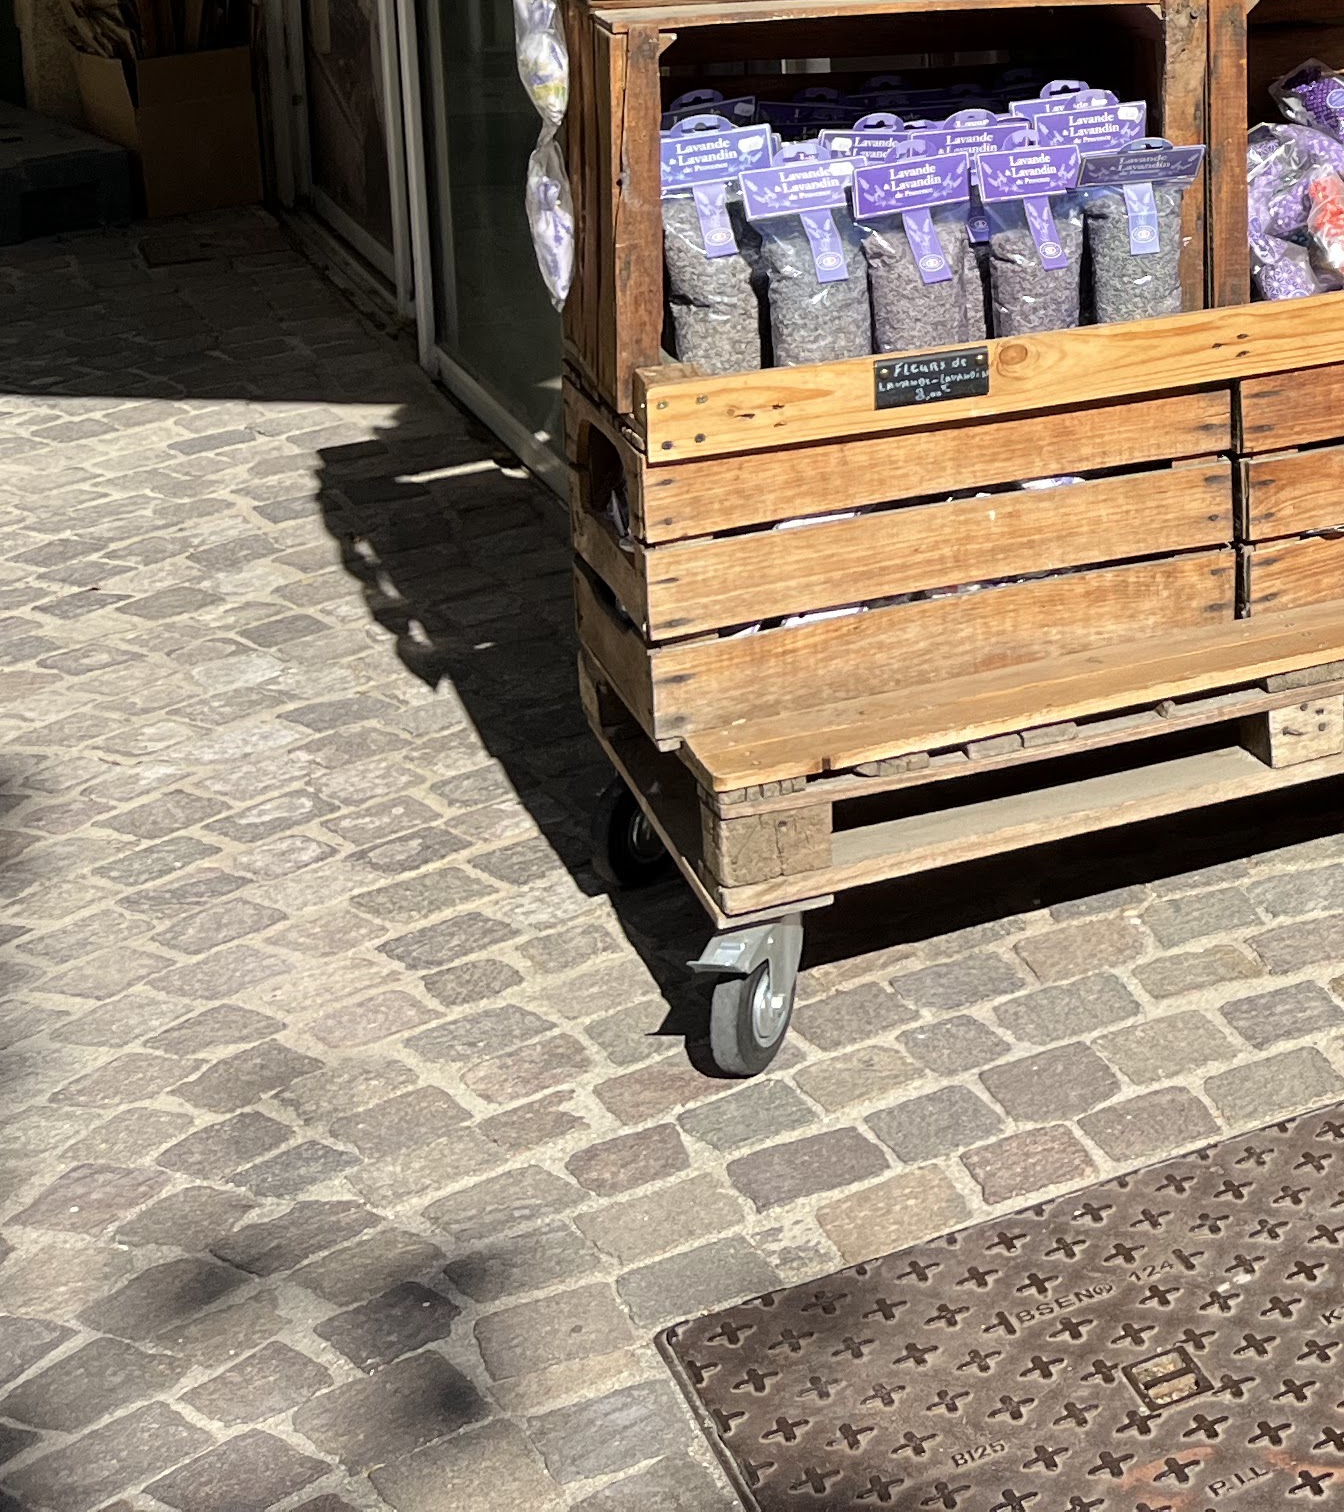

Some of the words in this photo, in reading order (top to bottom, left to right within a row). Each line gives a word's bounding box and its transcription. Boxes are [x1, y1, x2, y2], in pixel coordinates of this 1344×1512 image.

[1068, 112, 1114, 126] Lavande
[945, 132, 994, 145] Lavande
[1069, 123, 1120, 138] Lavandin
[675, 137, 731, 155] Lavande
[678, 149, 738, 167] Lavandin
[1009, 152, 1051, 167] Lavande
[780, 166, 829, 183] Lavande
[889, 163, 937, 182] Lavande
[1011, 164, 1057, 178] Lavandin
[783, 176, 839, 194] Lavandin
[890, 173, 942, 193] Lavandin
[951, 357, 967, 368] de
